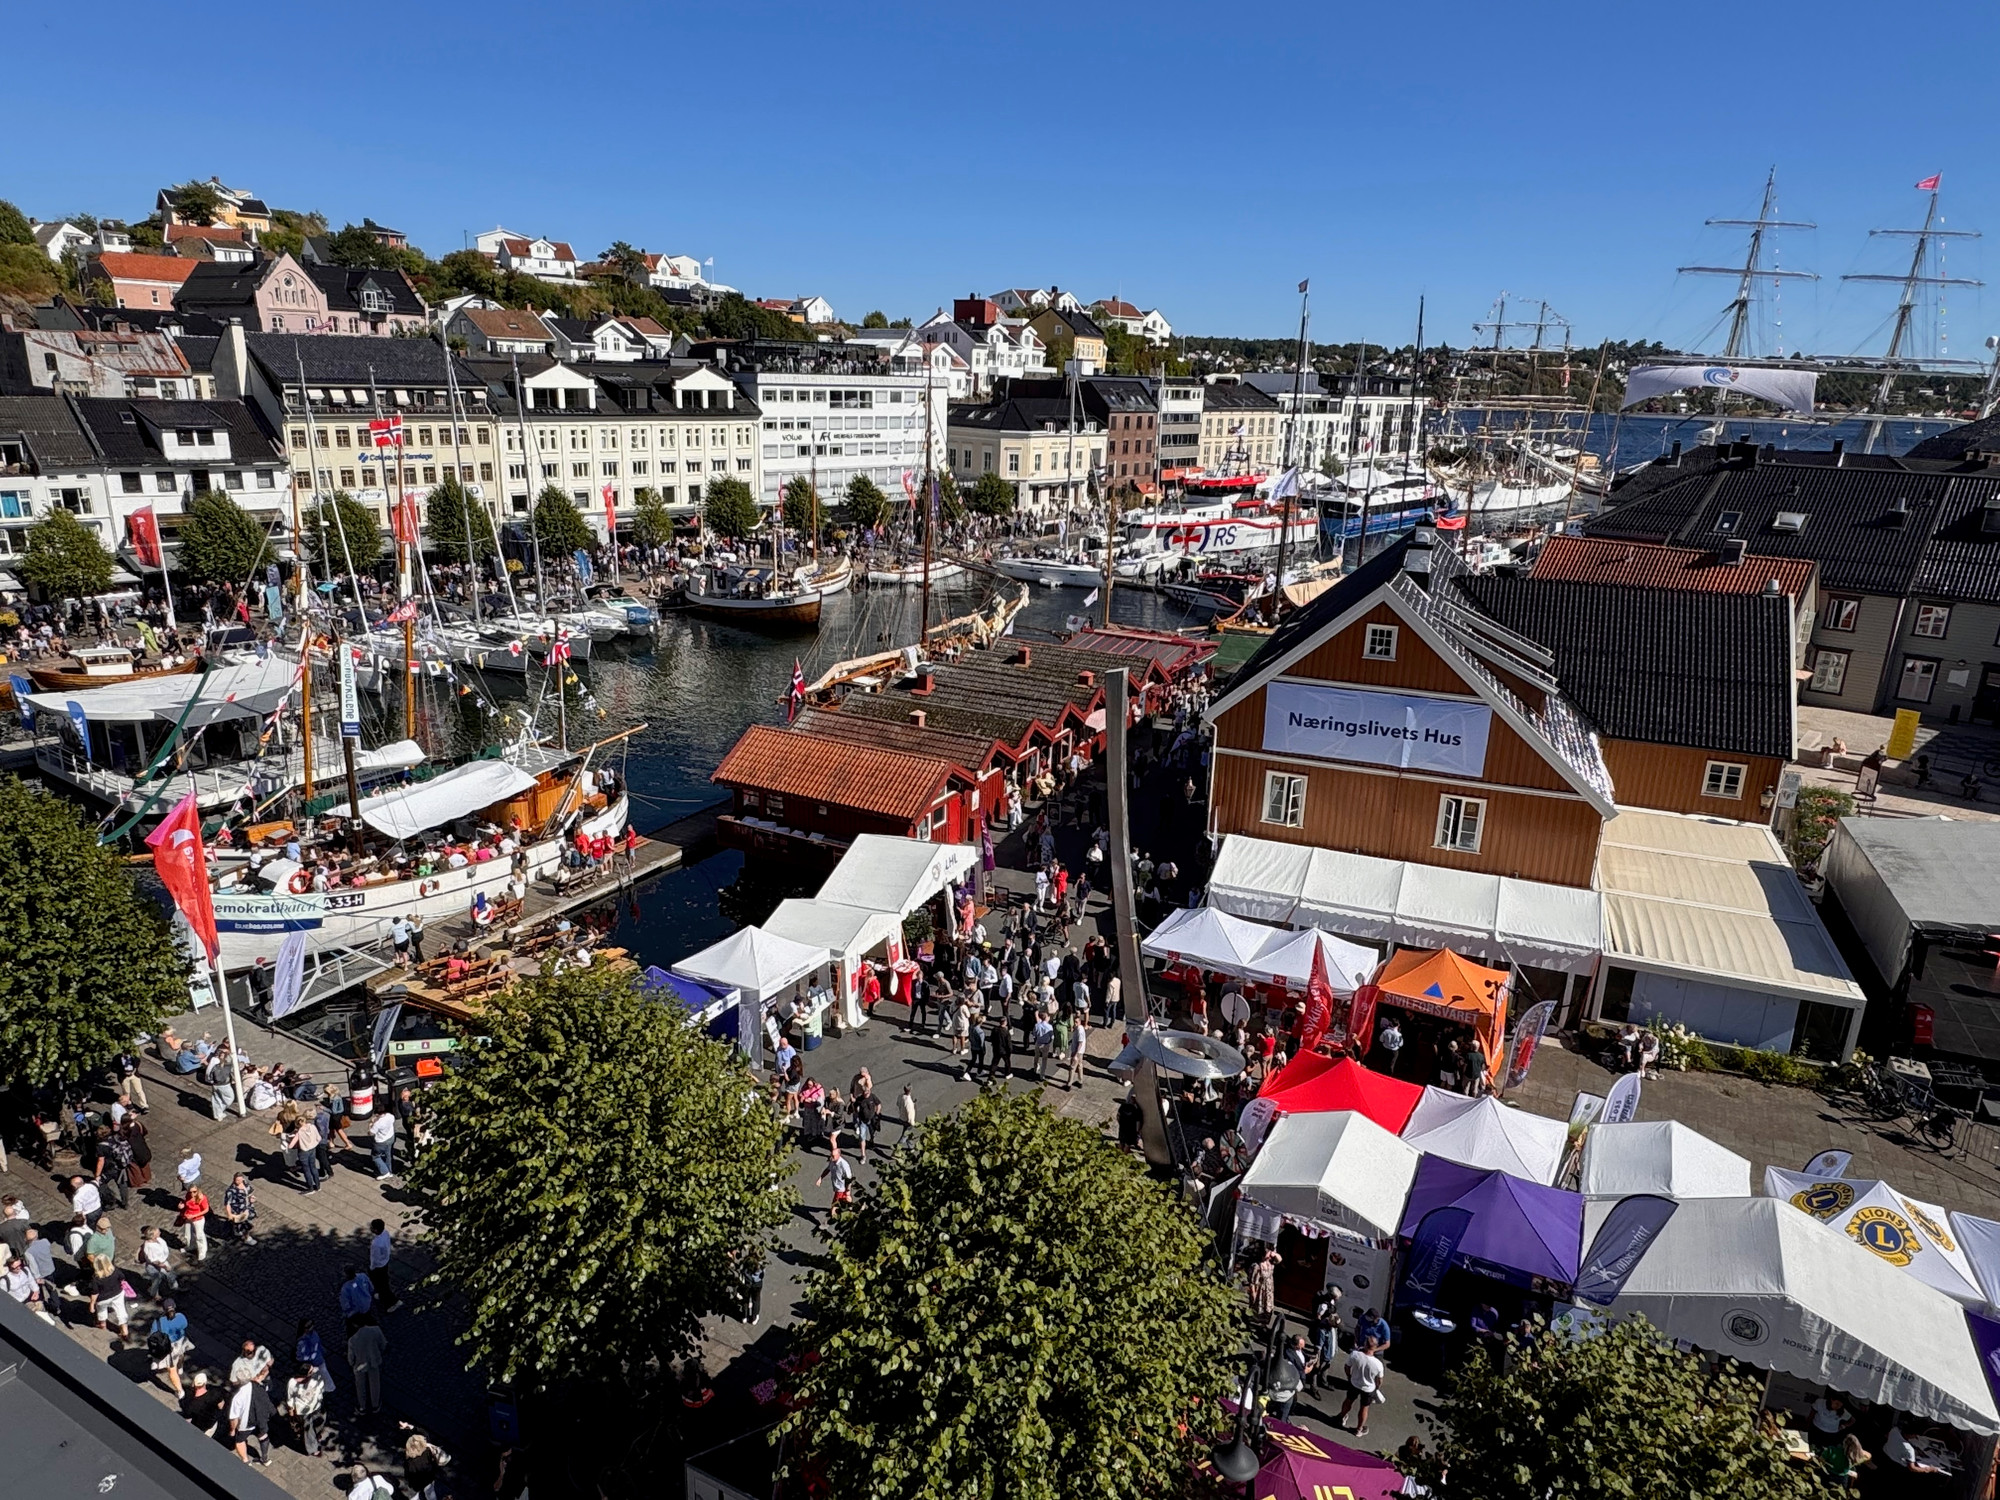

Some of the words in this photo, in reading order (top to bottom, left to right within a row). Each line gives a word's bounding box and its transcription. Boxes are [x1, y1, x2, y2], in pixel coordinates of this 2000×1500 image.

[1213, 525, 1238, 547] RS
[1288, 711, 1418, 741] Næringslivets
[1424, 728, 1462, 746] Hus
[945, 852, 958, 870] LHL
[1384, 993, 1479, 1024] SIVILFORSVARET
[1861, 1209, 1905, 1227] LIONS
[1875, 1224, 1895, 1249] L
[1782, 1338, 1814, 1354] NORSK
[1815, 1348, 1915, 1383] SYKEPLEIERFORBUND
